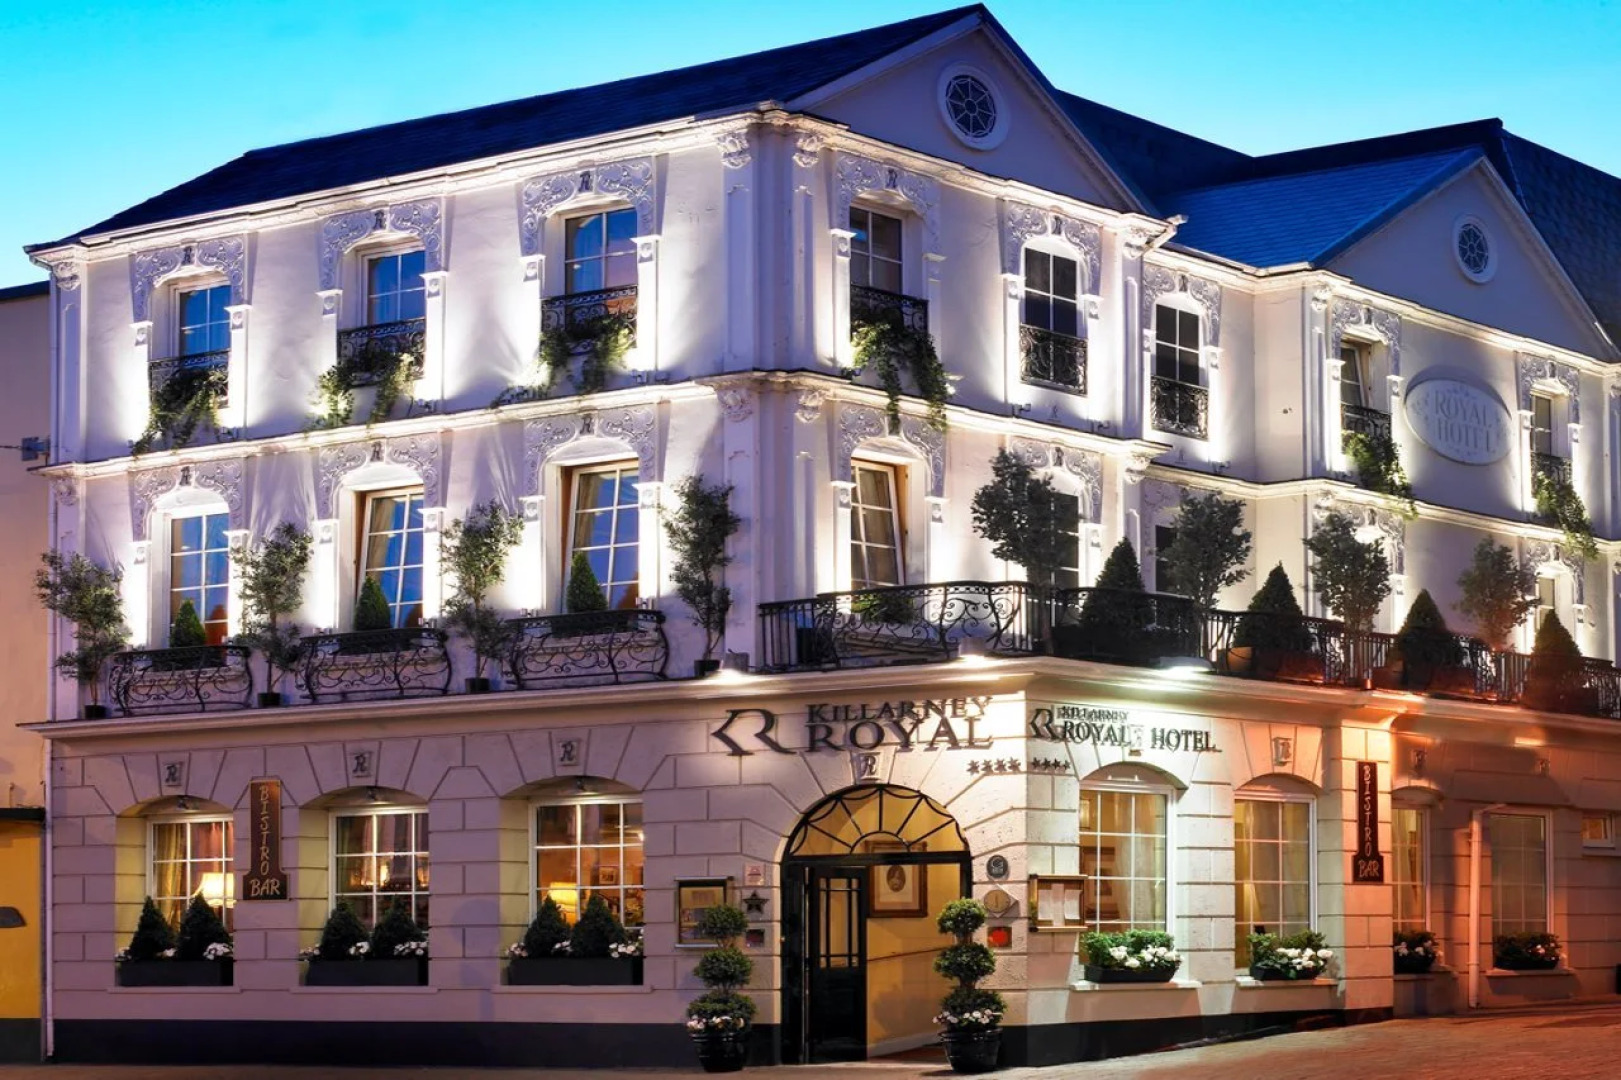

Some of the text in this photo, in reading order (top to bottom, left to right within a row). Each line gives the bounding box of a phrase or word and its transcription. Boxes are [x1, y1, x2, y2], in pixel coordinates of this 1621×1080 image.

[805, 697, 993, 723] KILLARNEY
[804, 716, 994, 752] ROYAL
[1062, 720, 1221, 752] ROYAL HOTEL
[1362, 765, 1373, 857] BISTRO
[259, 784, 272, 876] BISTRO
[1358, 860, 1380, 878] BAR
[249, 878, 281, 897] BAR
